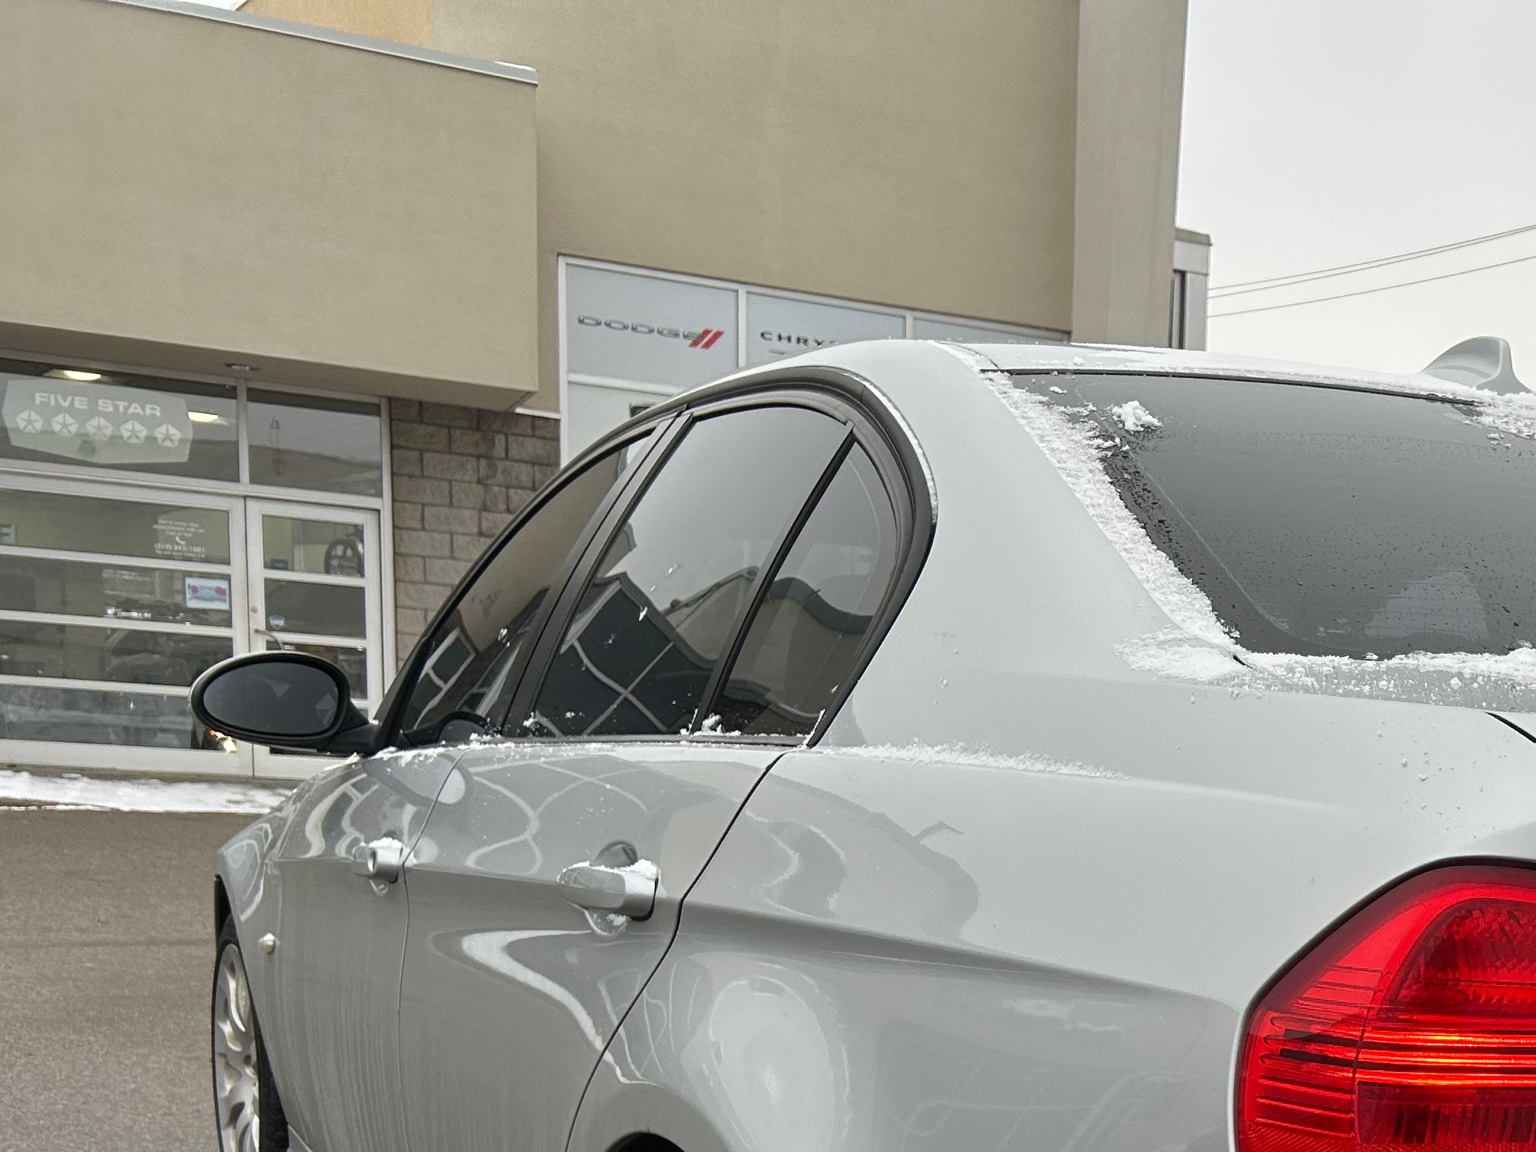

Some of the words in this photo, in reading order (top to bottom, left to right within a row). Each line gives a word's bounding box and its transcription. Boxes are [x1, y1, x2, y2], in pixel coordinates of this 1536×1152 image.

[578, 315, 702, 341] DODGE
[35, 391, 89, 410] FIVE
[98, 398, 162, 418] STAR
